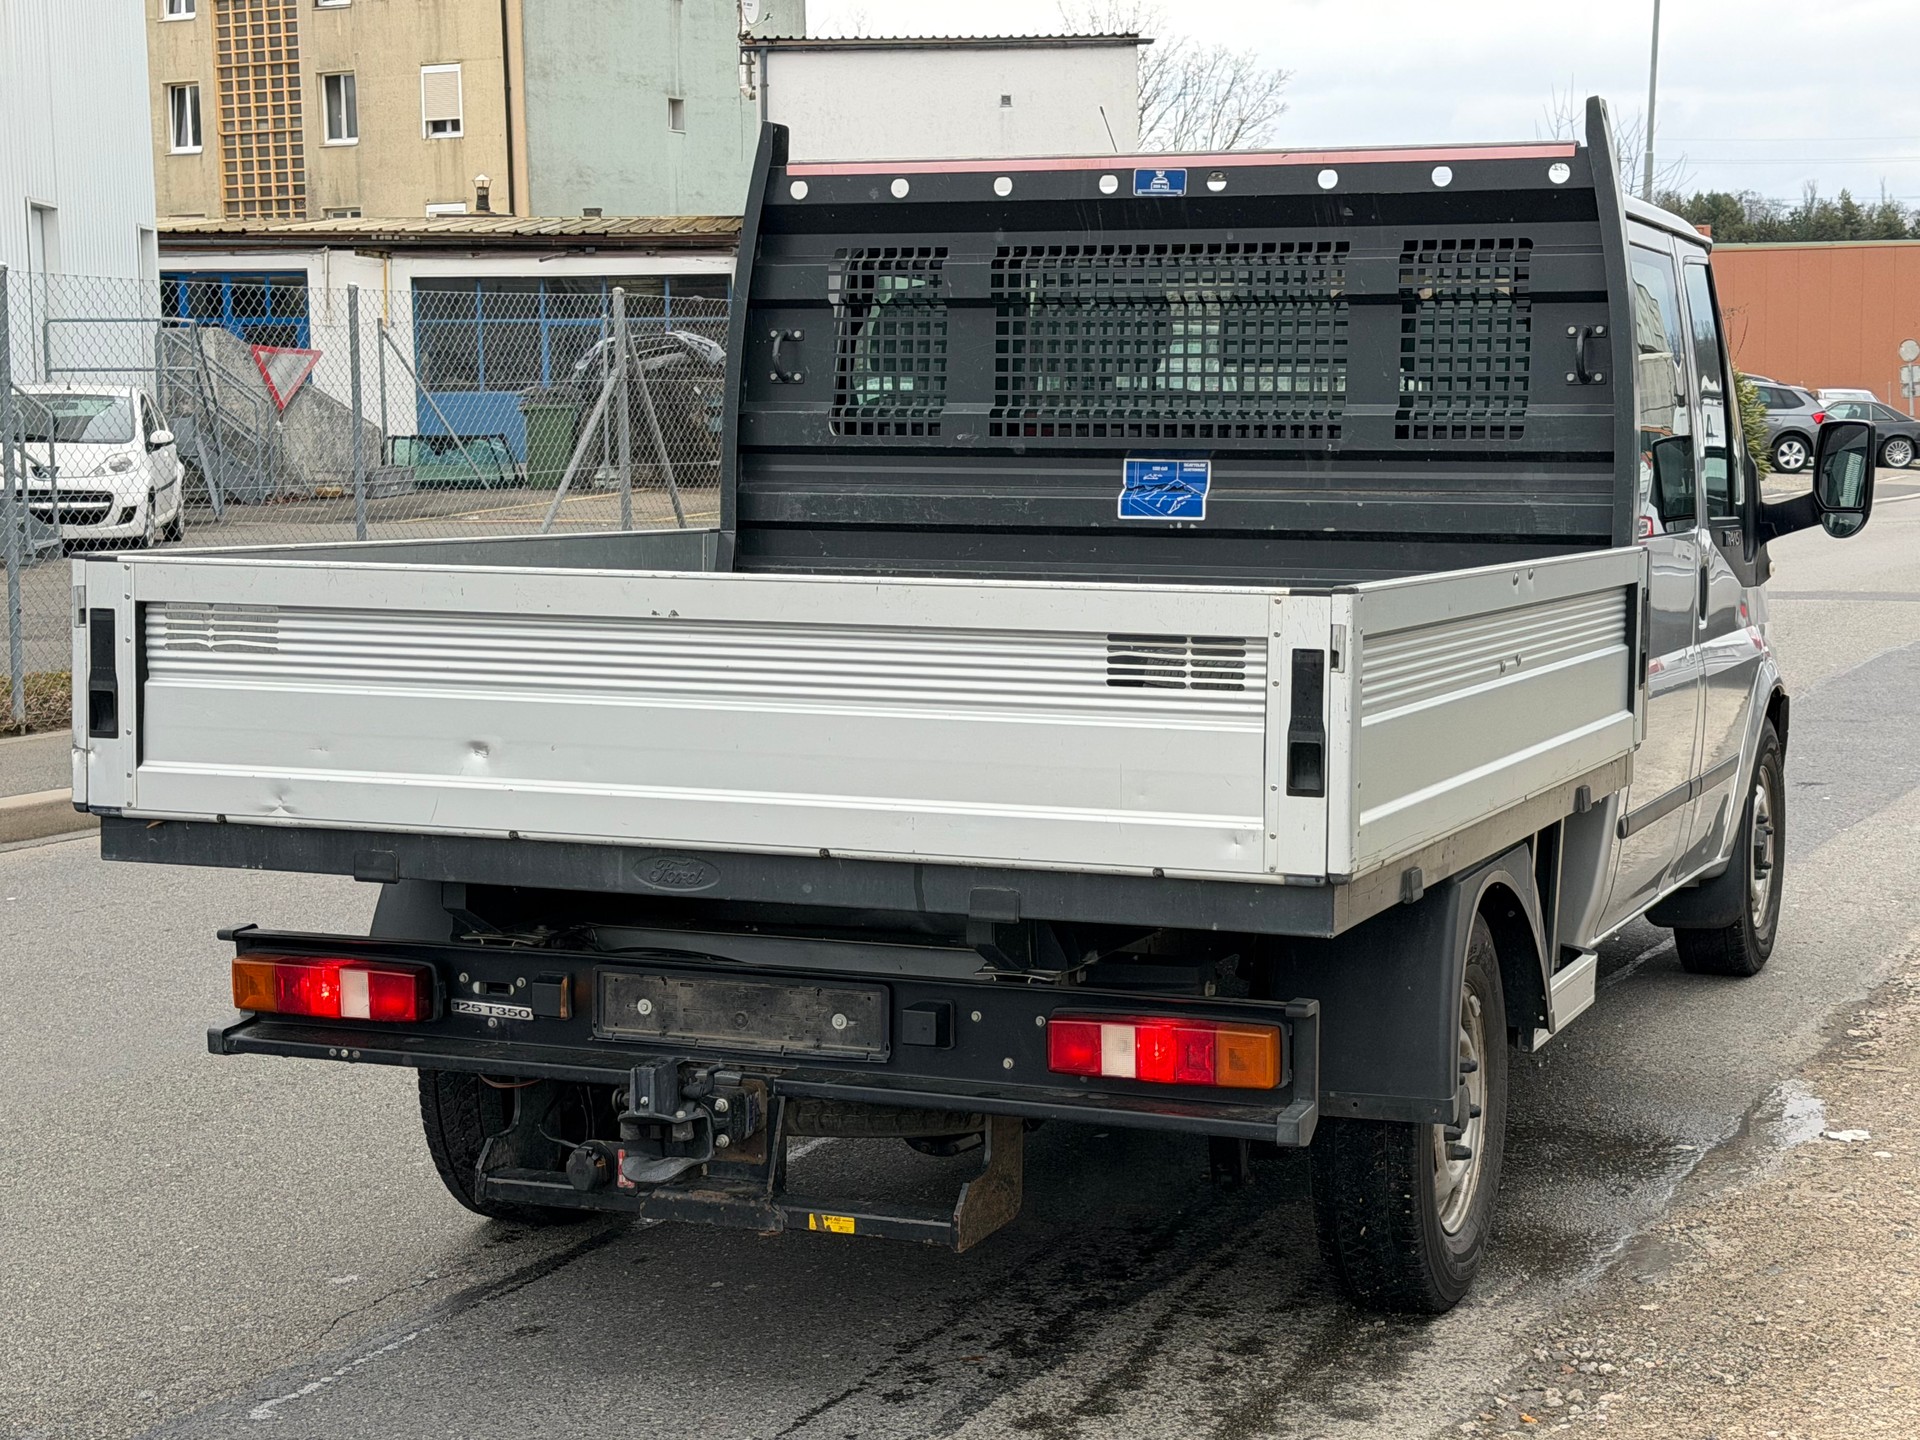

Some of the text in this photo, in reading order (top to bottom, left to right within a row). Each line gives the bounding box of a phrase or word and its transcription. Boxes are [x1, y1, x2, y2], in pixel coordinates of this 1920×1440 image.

[649, 859, 704, 885] Ford
[452, 1002, 530, 1019] 125 T350
